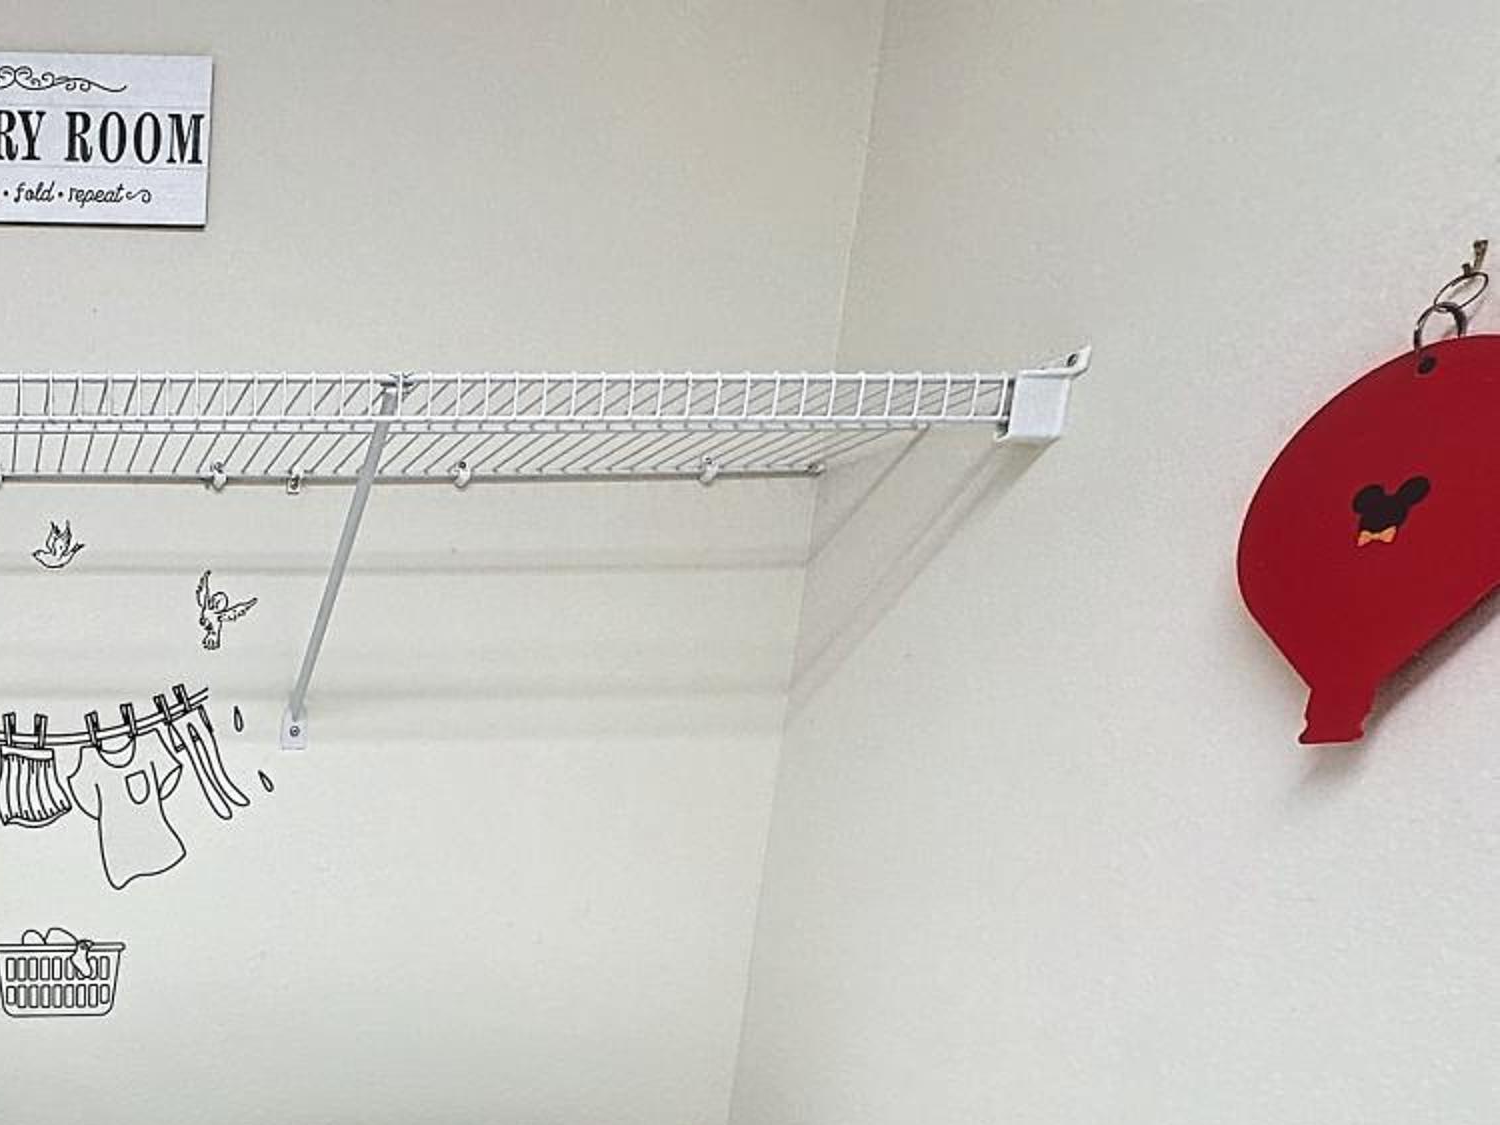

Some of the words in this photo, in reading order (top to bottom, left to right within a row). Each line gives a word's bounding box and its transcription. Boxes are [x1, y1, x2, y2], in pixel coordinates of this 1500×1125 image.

[66, 111, 205, 164] ROOM
[13, 180, 55, 203] fold
[68, 183, 125, 208] repeat
